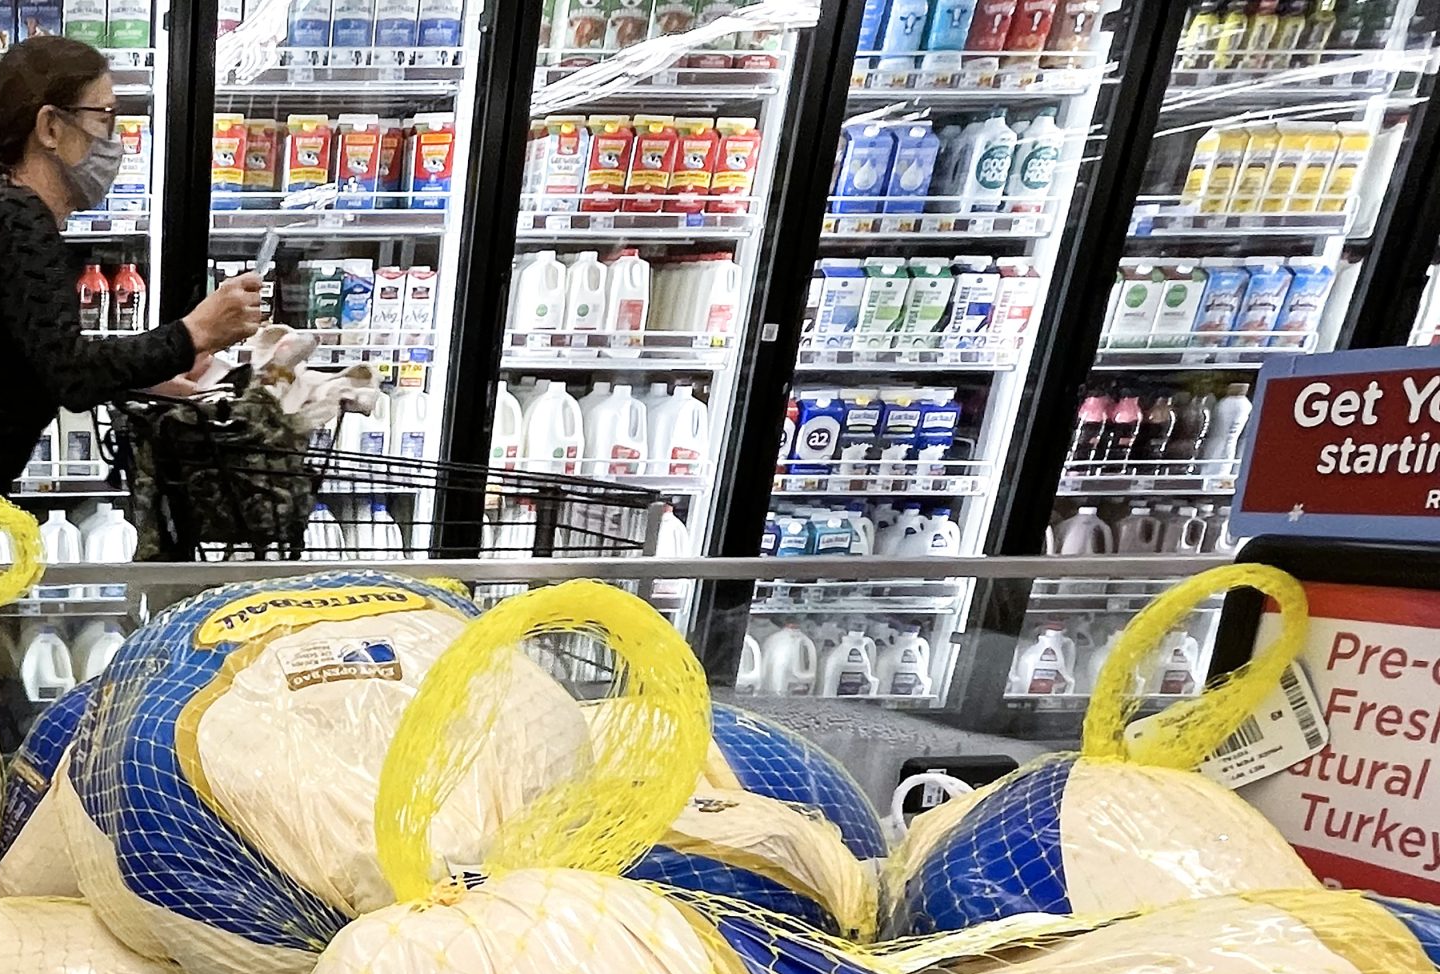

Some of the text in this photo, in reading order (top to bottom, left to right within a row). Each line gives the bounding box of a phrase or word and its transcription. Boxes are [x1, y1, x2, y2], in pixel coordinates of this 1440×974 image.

[1294, 381, 1383, 428] Get
[809, 433, 830, 446] a2
[216, 591, 409, 630] BUTTERBALL
[1327, 632, 1440, 687] Pre-
[1323, 688, 1440, 744] Fres
[1287, 743, 1431, 800] atural
